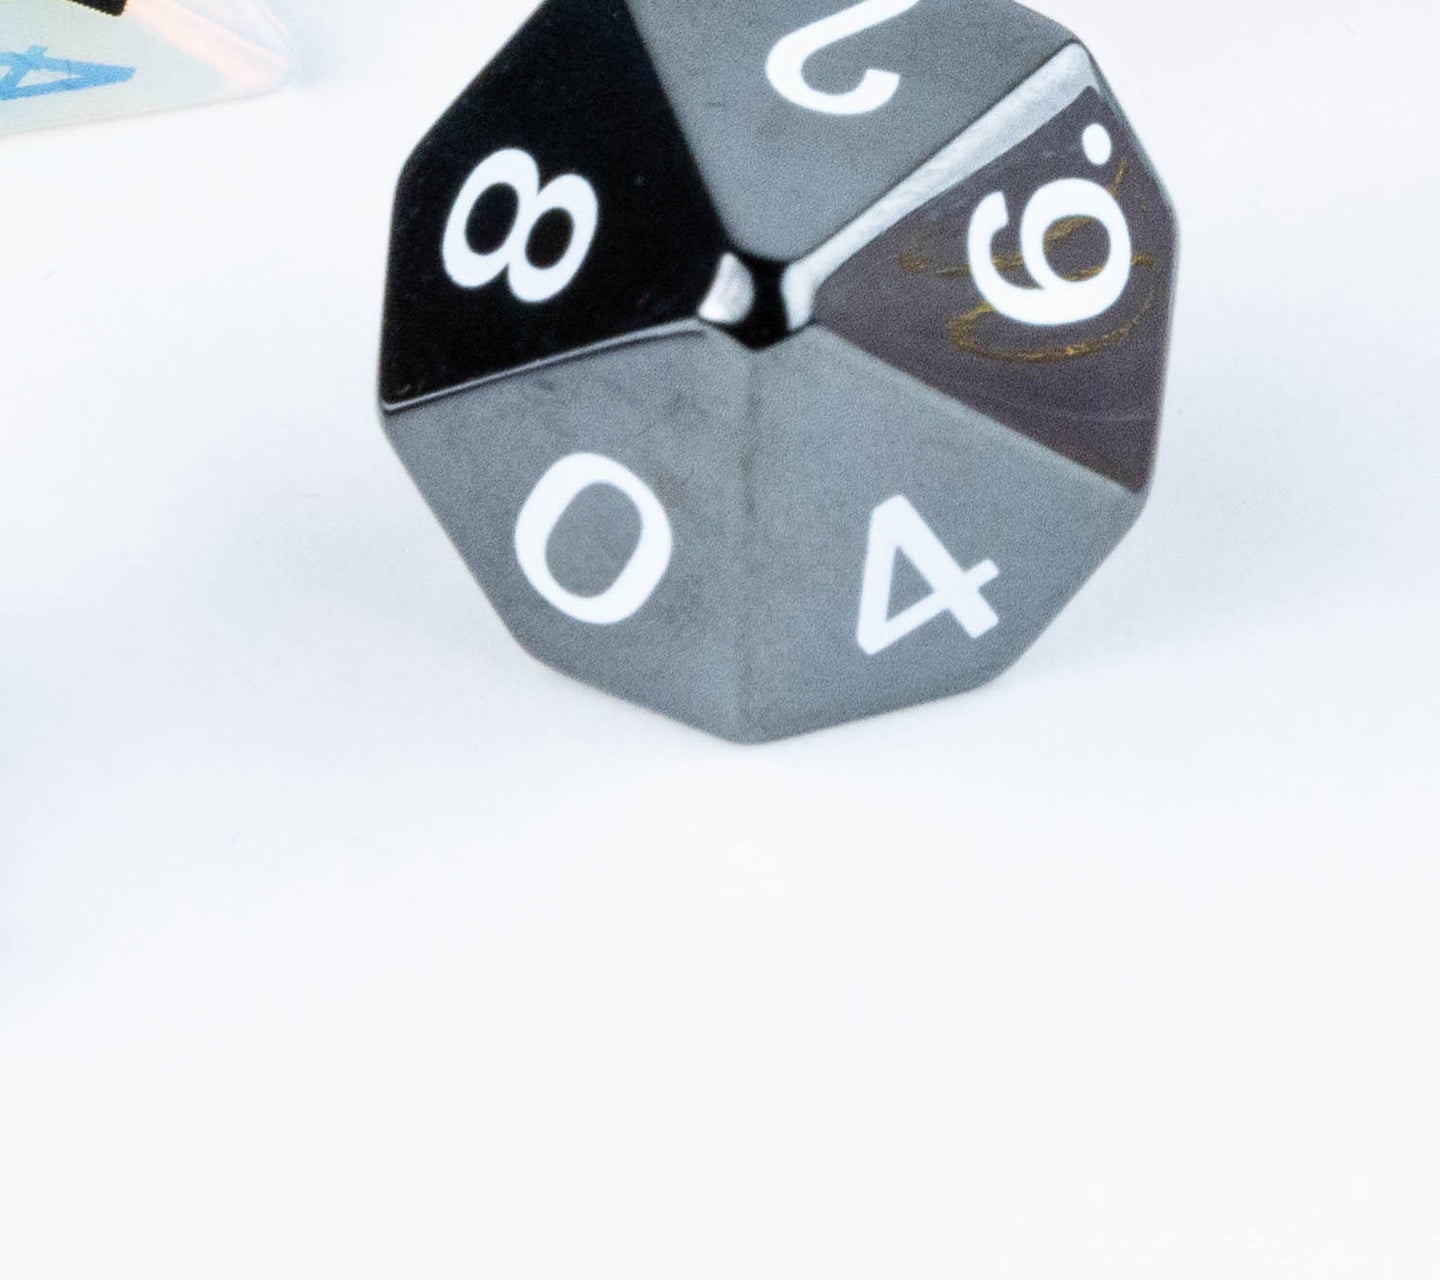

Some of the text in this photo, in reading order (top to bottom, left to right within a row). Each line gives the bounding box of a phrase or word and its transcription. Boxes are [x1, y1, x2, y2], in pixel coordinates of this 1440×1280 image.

[442, 147, 598, 303] 8
[514, 452, 673, 625] 0
[856, 494, 999, 656] 4
